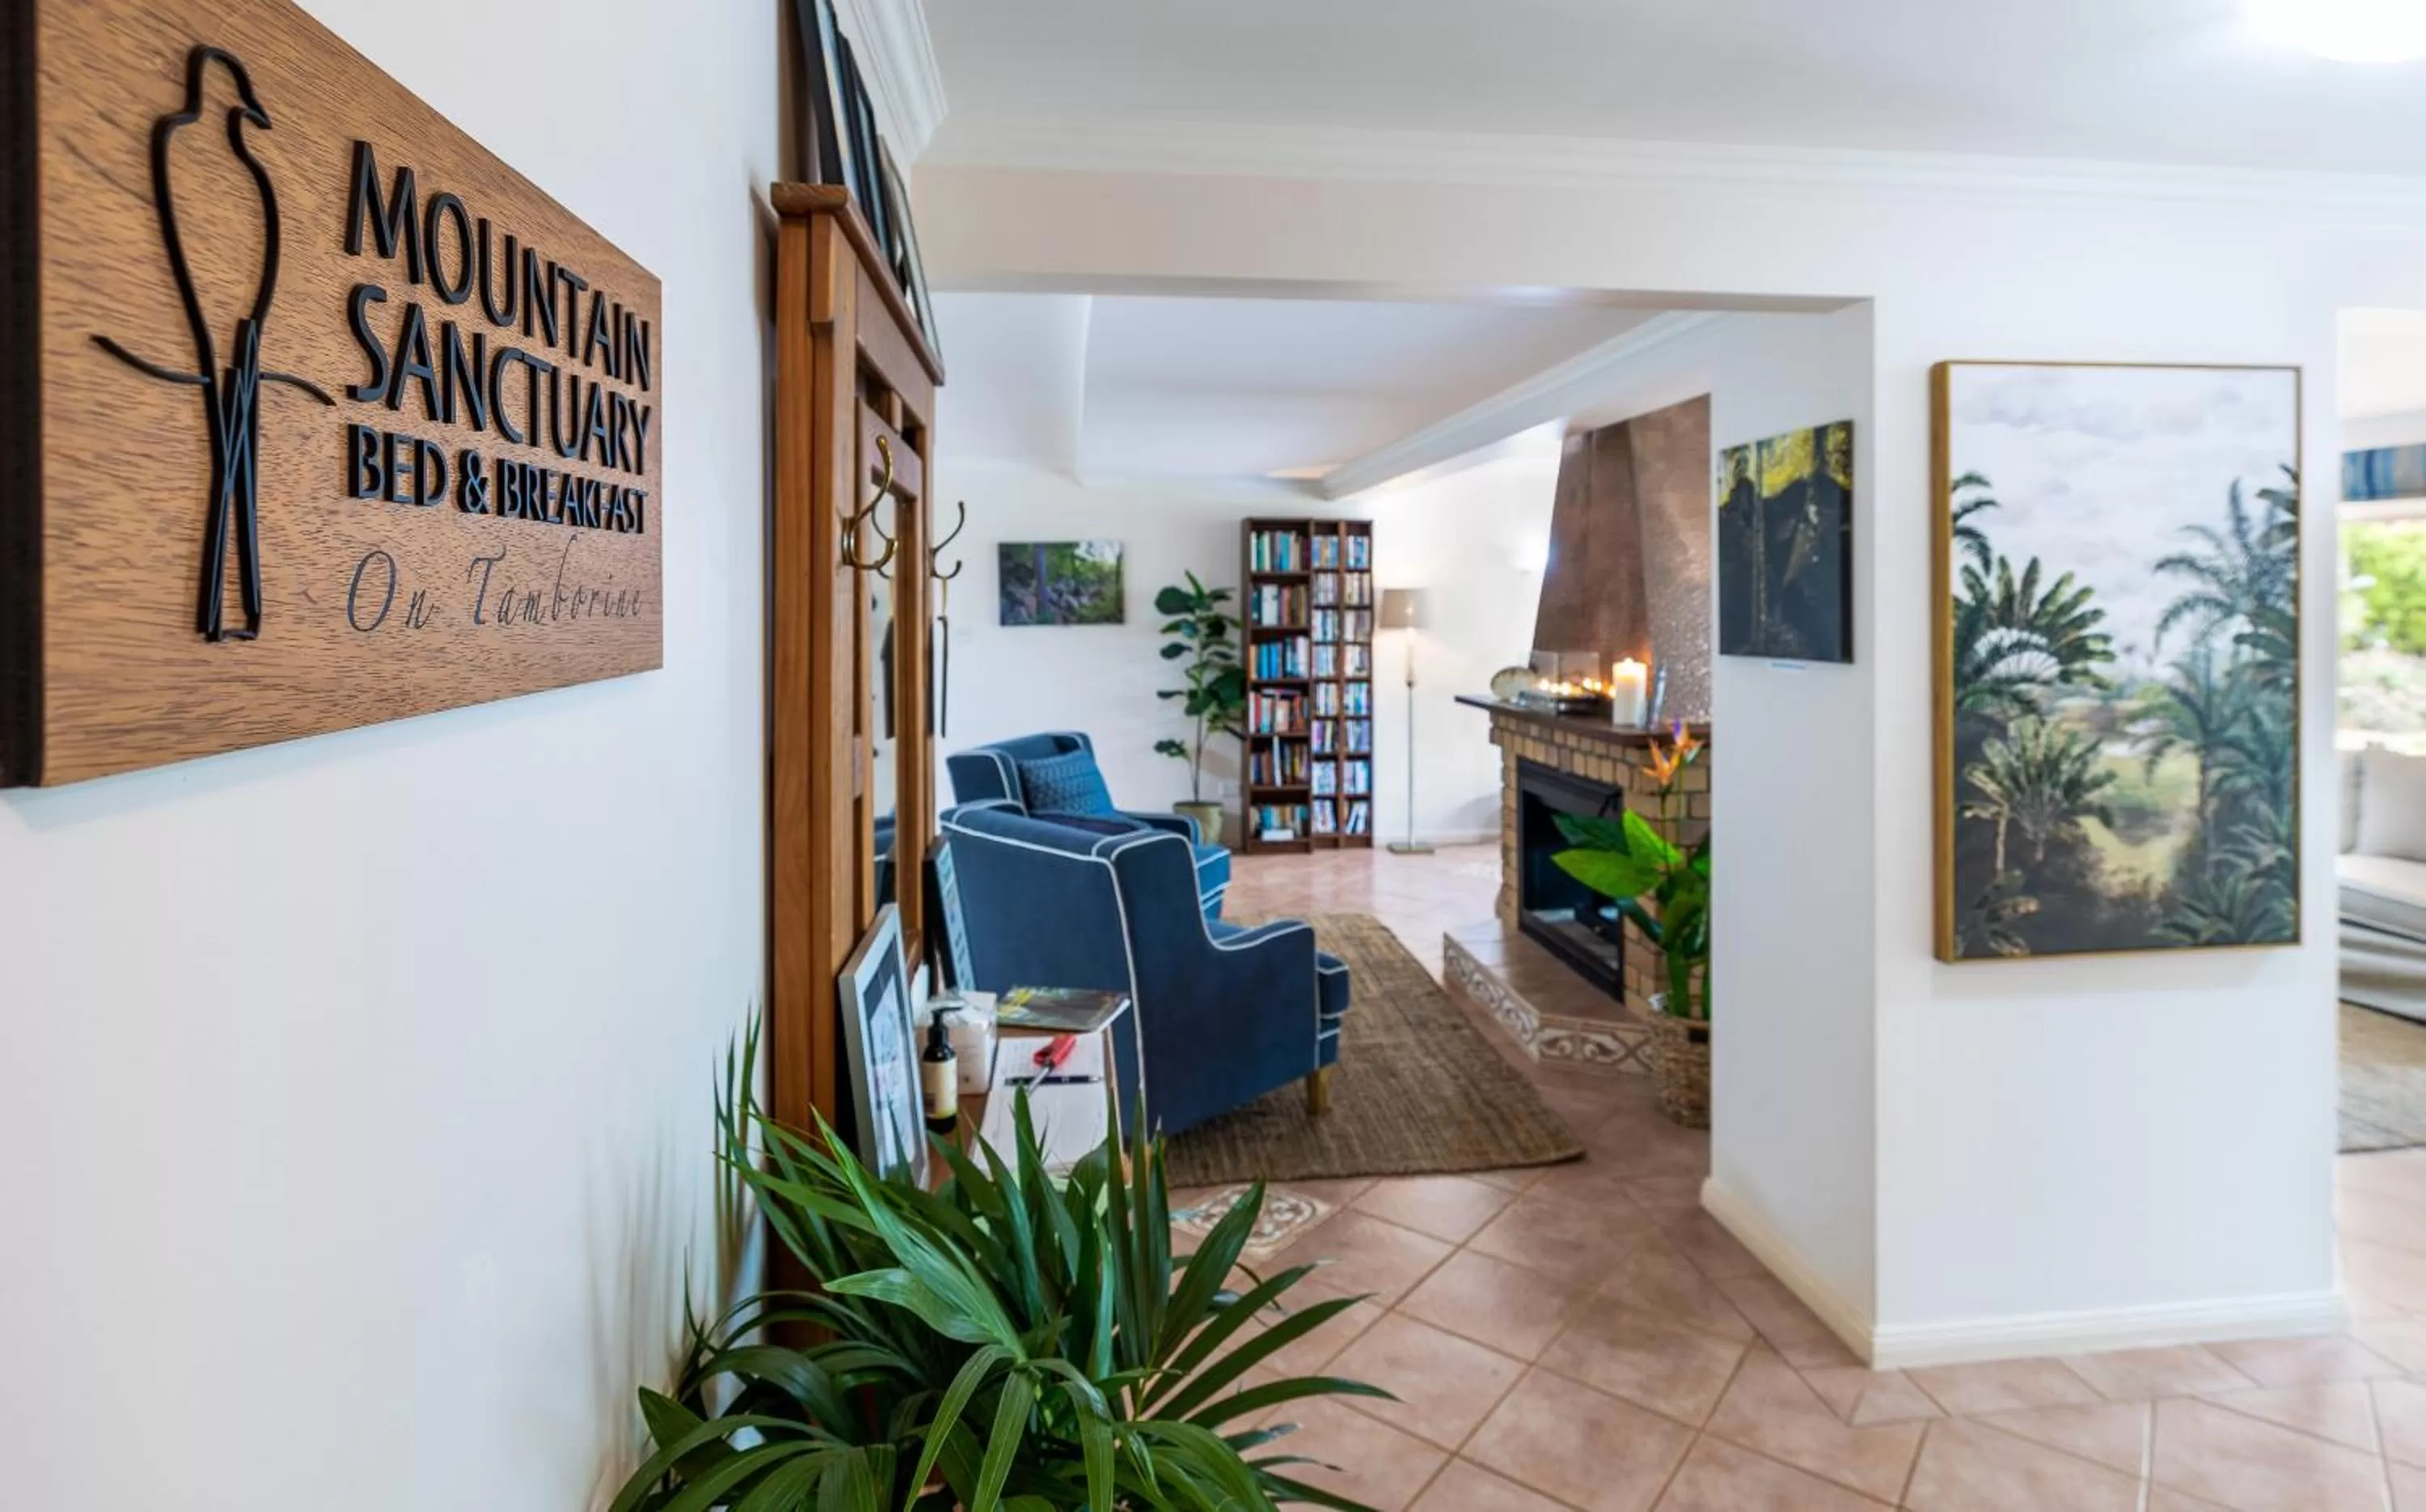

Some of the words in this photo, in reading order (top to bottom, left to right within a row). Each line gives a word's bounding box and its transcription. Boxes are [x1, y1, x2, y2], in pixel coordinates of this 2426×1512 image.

[345, 140, 650, 392] MOUNTAIN
[346, 283, 651, 475] SANCTUARY
[347, 423, 448, 507] BED
[457, 449, 489, 514] &
[496, 458, 648, 534] BREAKFAST
[347, 550, 435, 632] On
[467, 534, 644, 625] Tamborine
